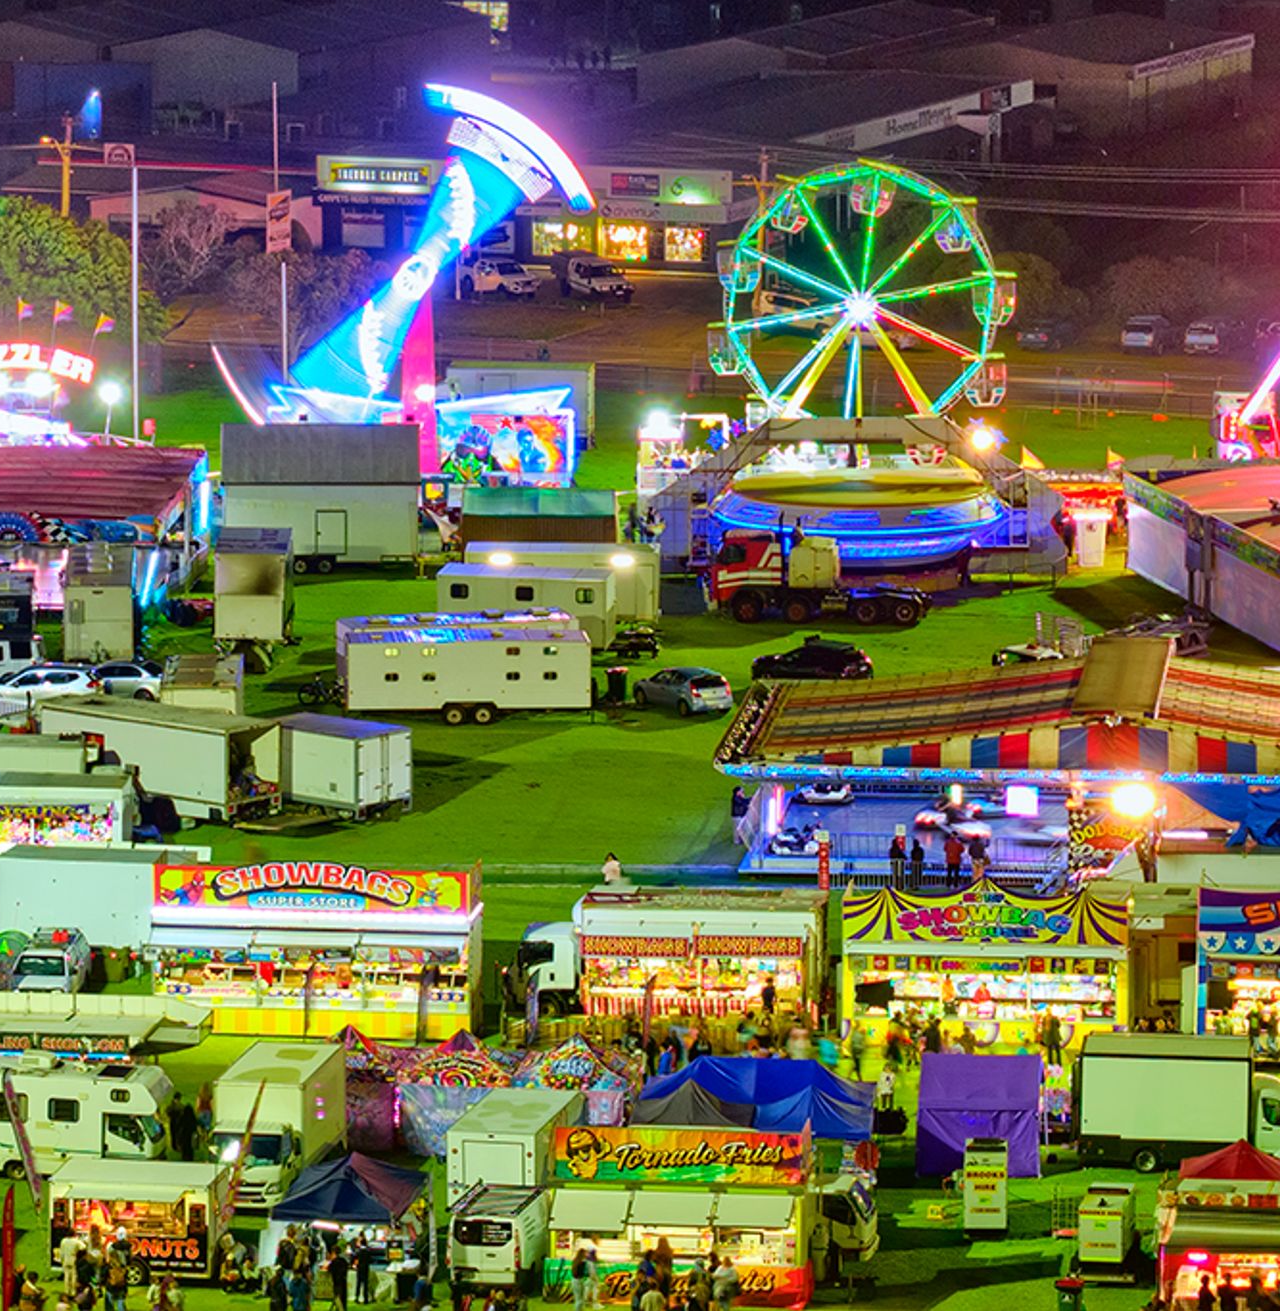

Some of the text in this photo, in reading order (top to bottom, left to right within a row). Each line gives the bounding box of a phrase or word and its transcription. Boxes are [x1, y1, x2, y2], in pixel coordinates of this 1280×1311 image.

[215, 862, 412, 903] SHOWBAGS
[256, 895, 358, 909] SUPER STORE
[896, 906, 1073, 936] SHOWBAG
[931, 924, 1038, 938] CAROUSEL
[581, 937, 687, 955] SHOWBAGS
[695, 937, 803, 955] SHOWBAGS
[615, 1138, 783, 1170] Tornado Fries
[966, 1171, 1005, 1179] BROOKS
[974, 1183, 996, 1191] HIRE
[128, 1238, 200, 1259] ONUTS
